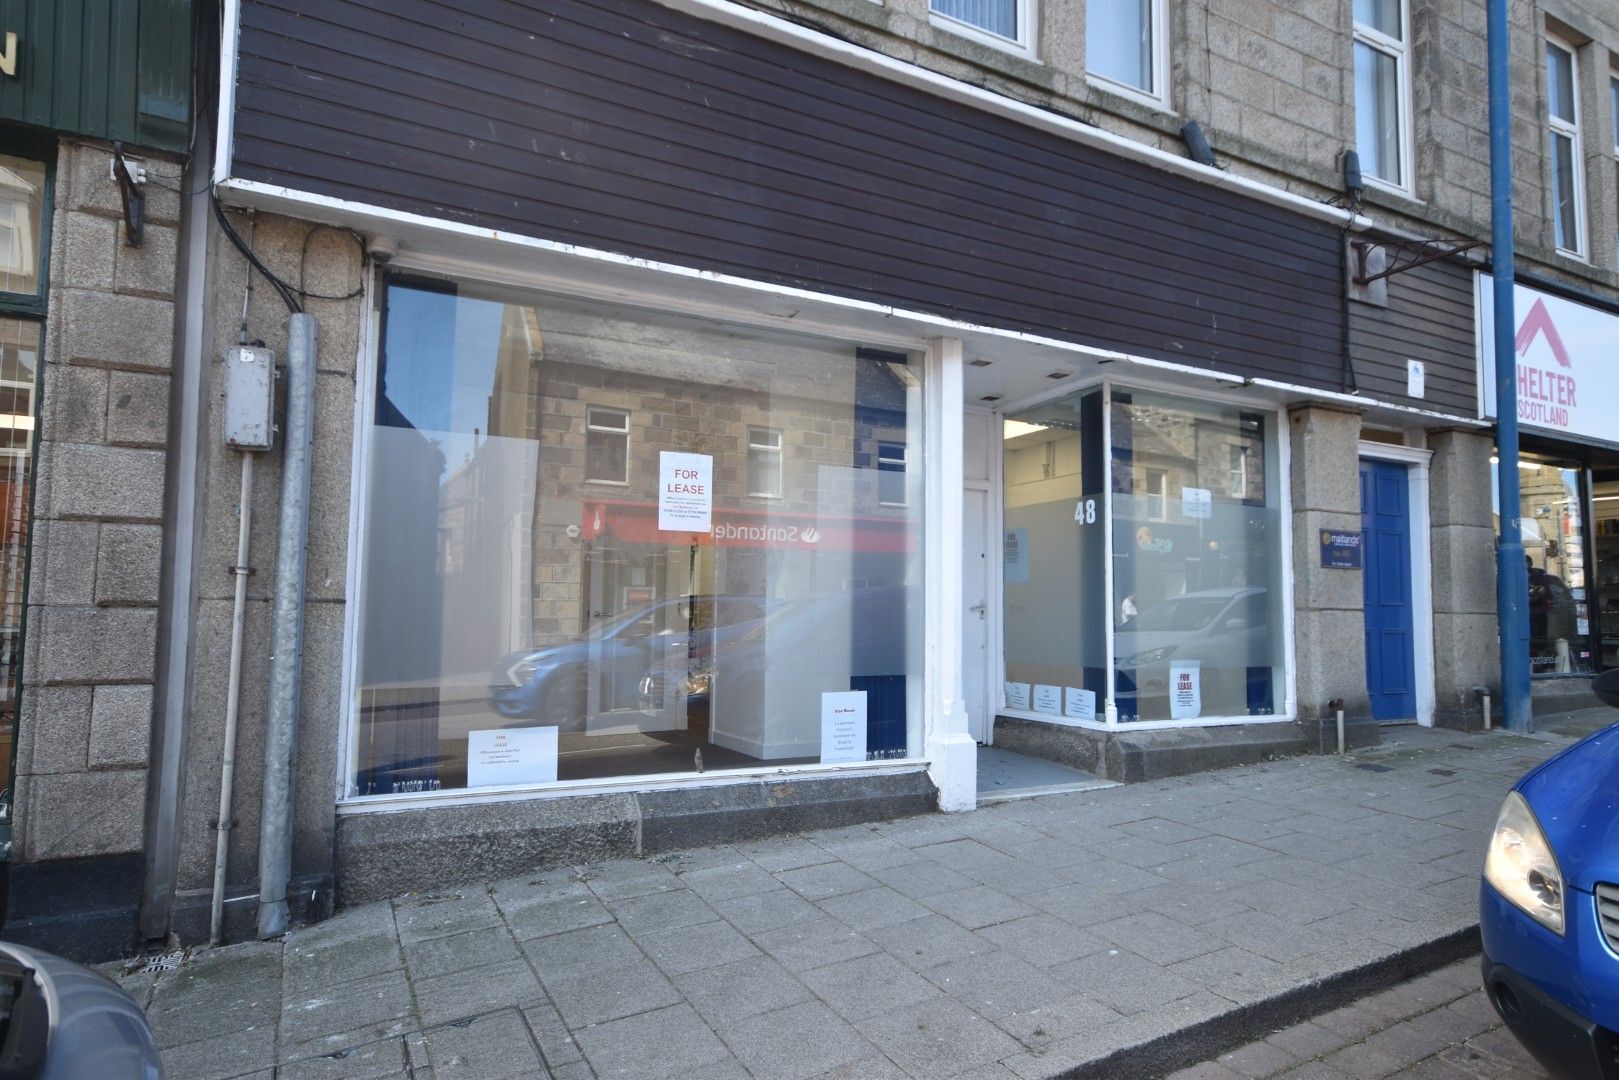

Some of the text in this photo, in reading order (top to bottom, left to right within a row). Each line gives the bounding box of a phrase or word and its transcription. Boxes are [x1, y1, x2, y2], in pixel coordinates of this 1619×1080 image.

[1517, 364, 1577, 408] HELTER
[1518, 400, 1569, 427] SCOTLAND
[674, 469, 699, 480] FOR
[667, 484, 705, 495] LEASE
[1074, 499, 1096, 526] 48
[1180, 673, 1190, 681] FOR
[1177, 682, 1193, 690] LEASE
